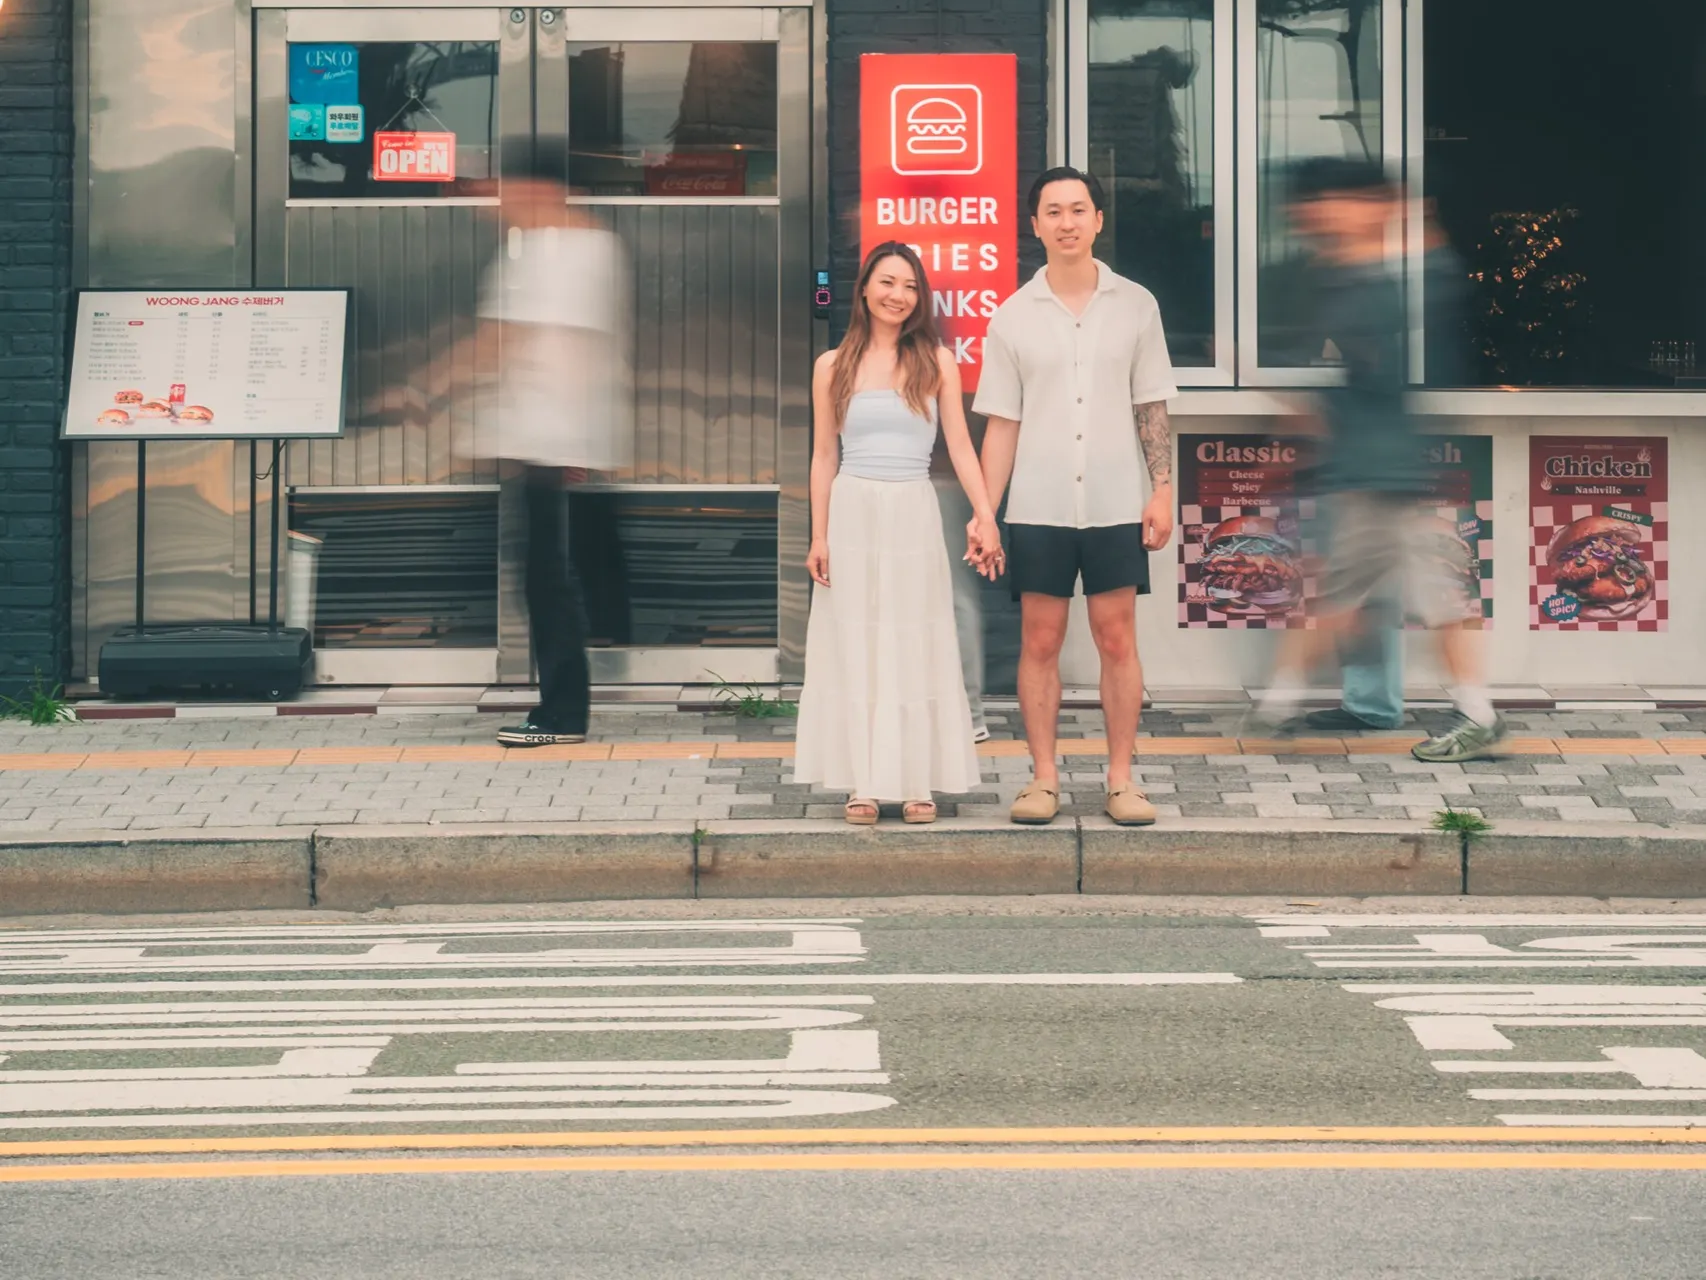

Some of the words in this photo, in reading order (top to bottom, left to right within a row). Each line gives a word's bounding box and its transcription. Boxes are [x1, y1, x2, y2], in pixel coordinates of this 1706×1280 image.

[305, 50, 353, 67] CESCO
[380, 149, 448, 174] OPEN
[876, 197, 999, 225] BURGER
[146, 297, 200, 306] WOONG
[202, 297, 239, 306] JANG
[242, 297, 285, 306] 수제버거
[932, 289, 998, 318] NKS
[1196, 440, 1296, 463] Classic
[1544, 454, 1653, 479] Chicken
[1228, 470, 1265, 479] Cheese
[1232, 482, 1261, 493] Spicy
[1574, 485, 1622, 495] Nashville
[1222, 496, 1271, 506] Barbecue
[1611, 509, 1643, 523] CRISPY
[1548, 596, 1566, 609] HOT
[1550, 602, 1577, 617] SPICY
[524, 734, 557, 743] crocs
